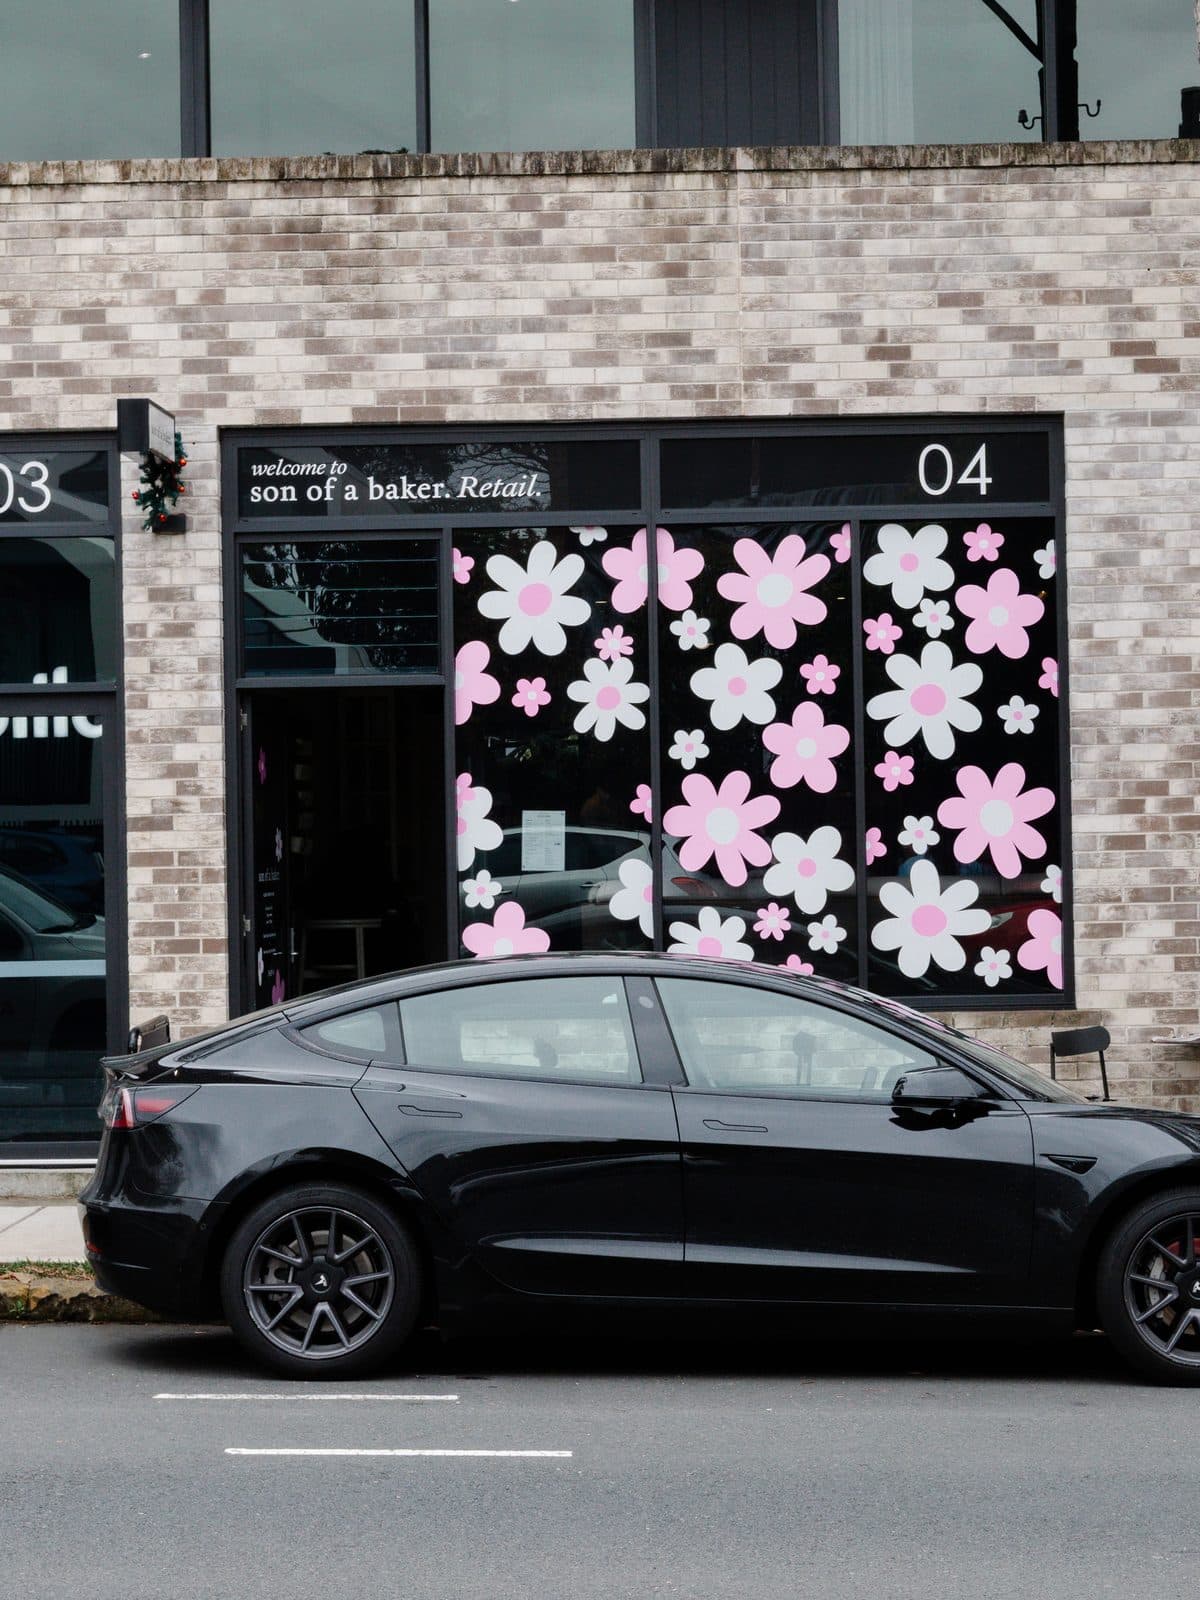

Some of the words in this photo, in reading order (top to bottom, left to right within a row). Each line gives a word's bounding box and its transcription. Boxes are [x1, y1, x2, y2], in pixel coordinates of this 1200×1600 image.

[251, 458, 327, 477] welcome
[330, 460, 348, 476] to
[918, 443, 993, 496] 04
[250, 485, 298, 503] son
[306, 475, 338, 502] of
[344, 484, 359, 501] a
[367, 475, 451, 501] baker.
[456, 473, 543, 499] Retail.
